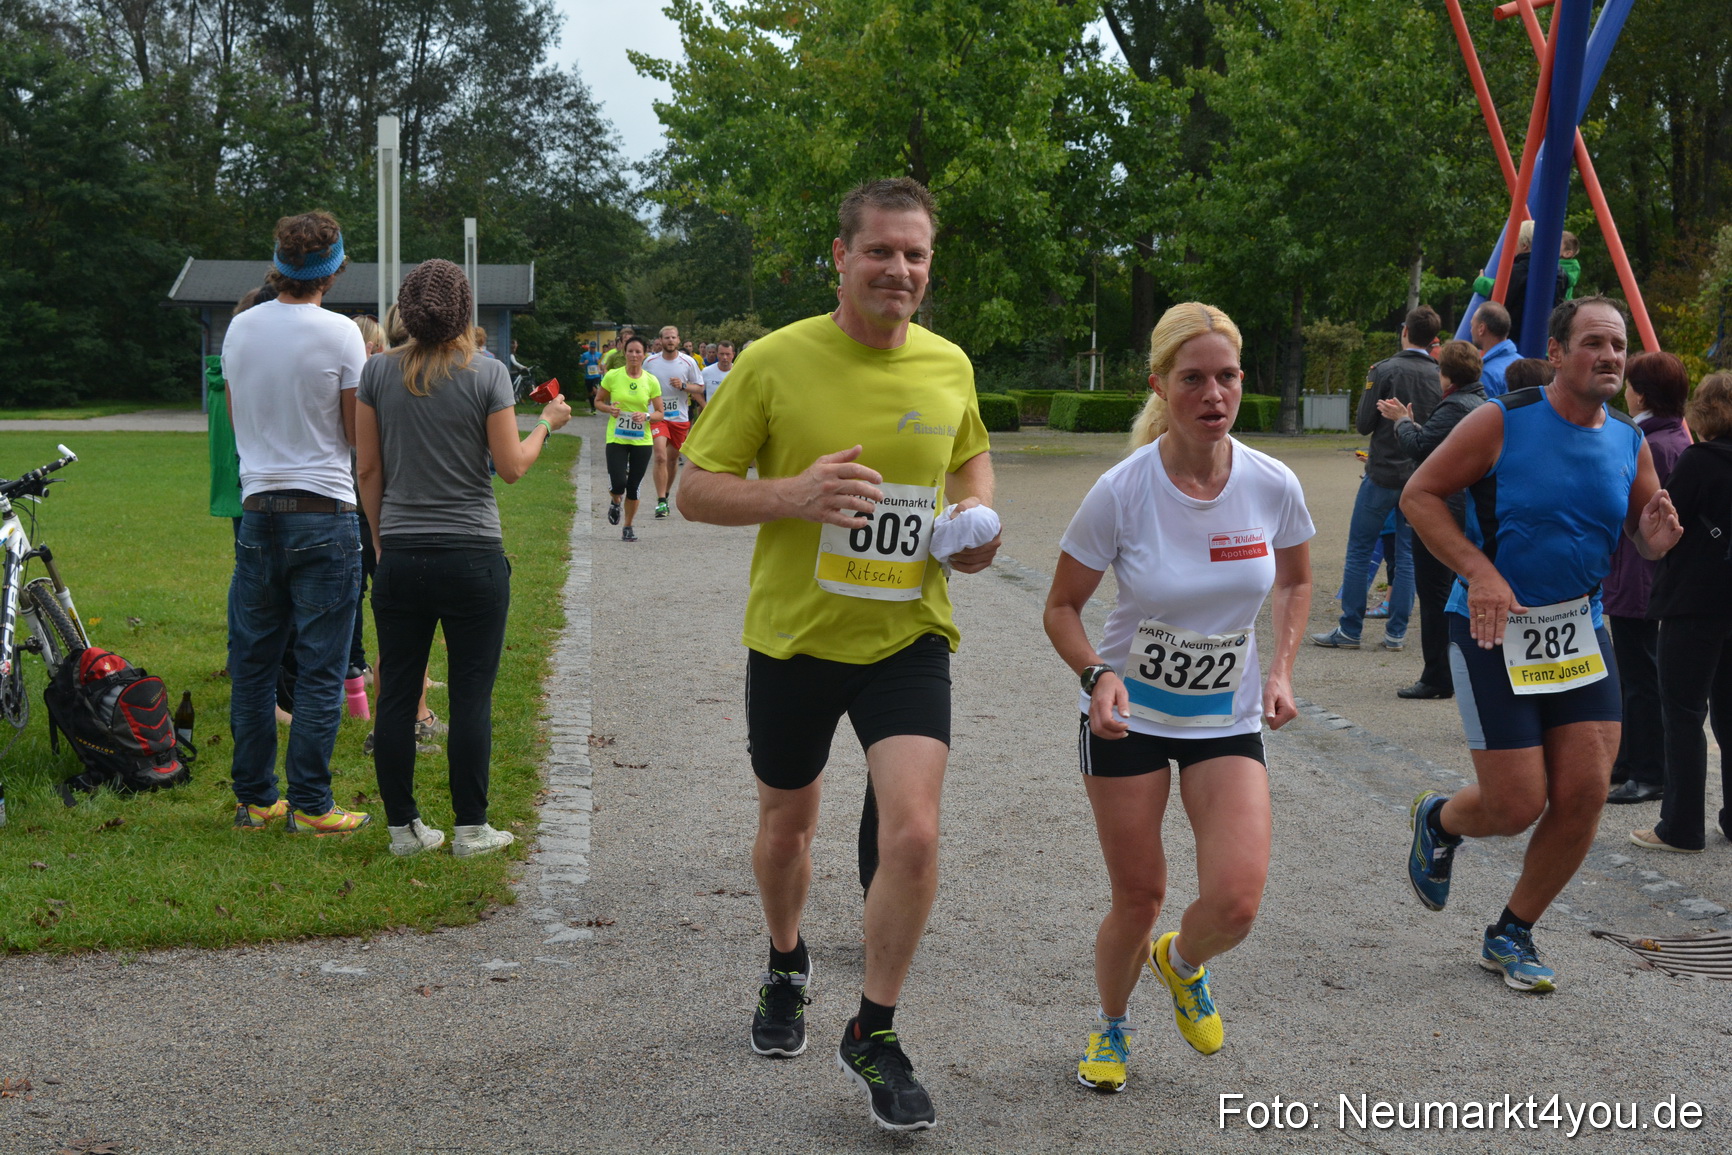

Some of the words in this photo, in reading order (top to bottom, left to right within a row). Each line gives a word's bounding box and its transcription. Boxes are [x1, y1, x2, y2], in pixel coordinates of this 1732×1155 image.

[913, 423, 946, 436] Ritschi
[849, 511, 922, 557] 603
[1231, 533, 1263, 544] Wildbad
[1220, 547, 1262, 559] Apotheke
[845, 561, 903, 584] Ritschi
[1538, 609, 1578, 623] Neumarkt
[1523, 622, 1579, 660] 282
[1139, 643, 1236, 690] 3322
[1521, 669, 1556, 682] Franz
[1558, 660, 1591, 680] Josef
